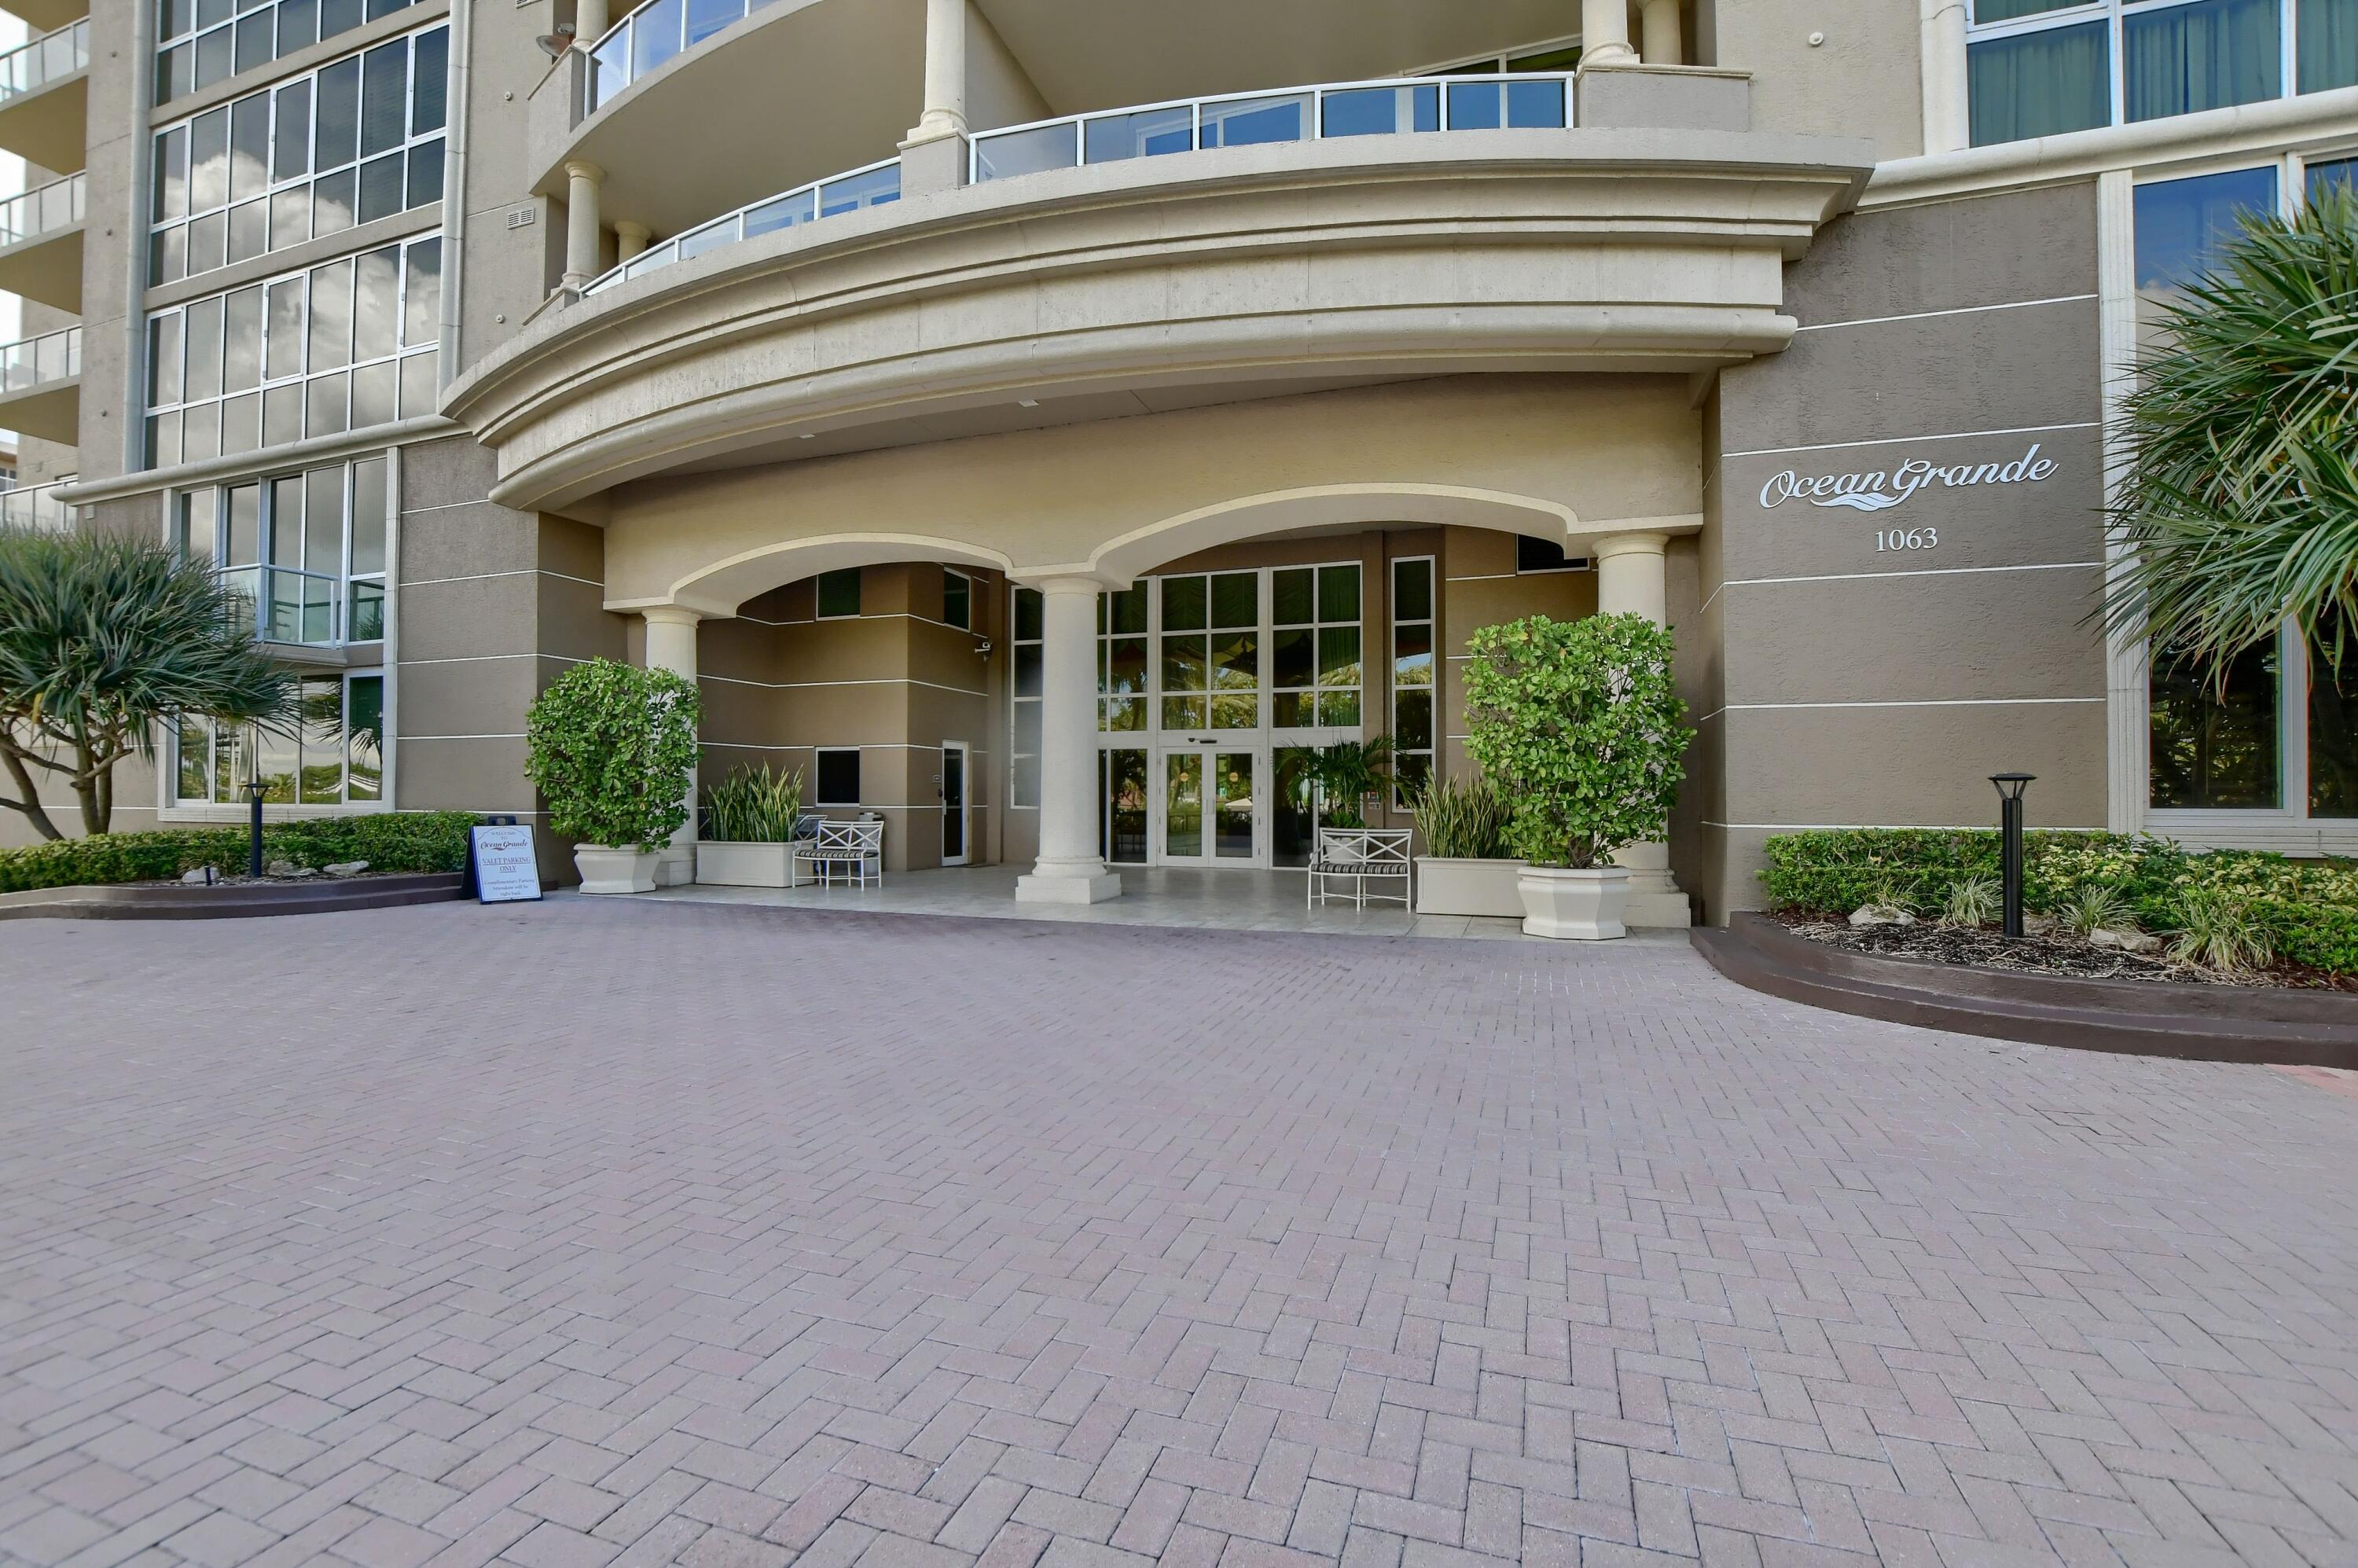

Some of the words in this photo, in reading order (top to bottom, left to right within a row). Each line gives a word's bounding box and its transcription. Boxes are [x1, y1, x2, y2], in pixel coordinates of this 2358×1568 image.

[1759, 470, 1886, 509] Ocean
[1892, 443, 2060, 506] Grande
[1875, 527, 1939, 553] 1063
[503, 839, 527, 849] Grande
